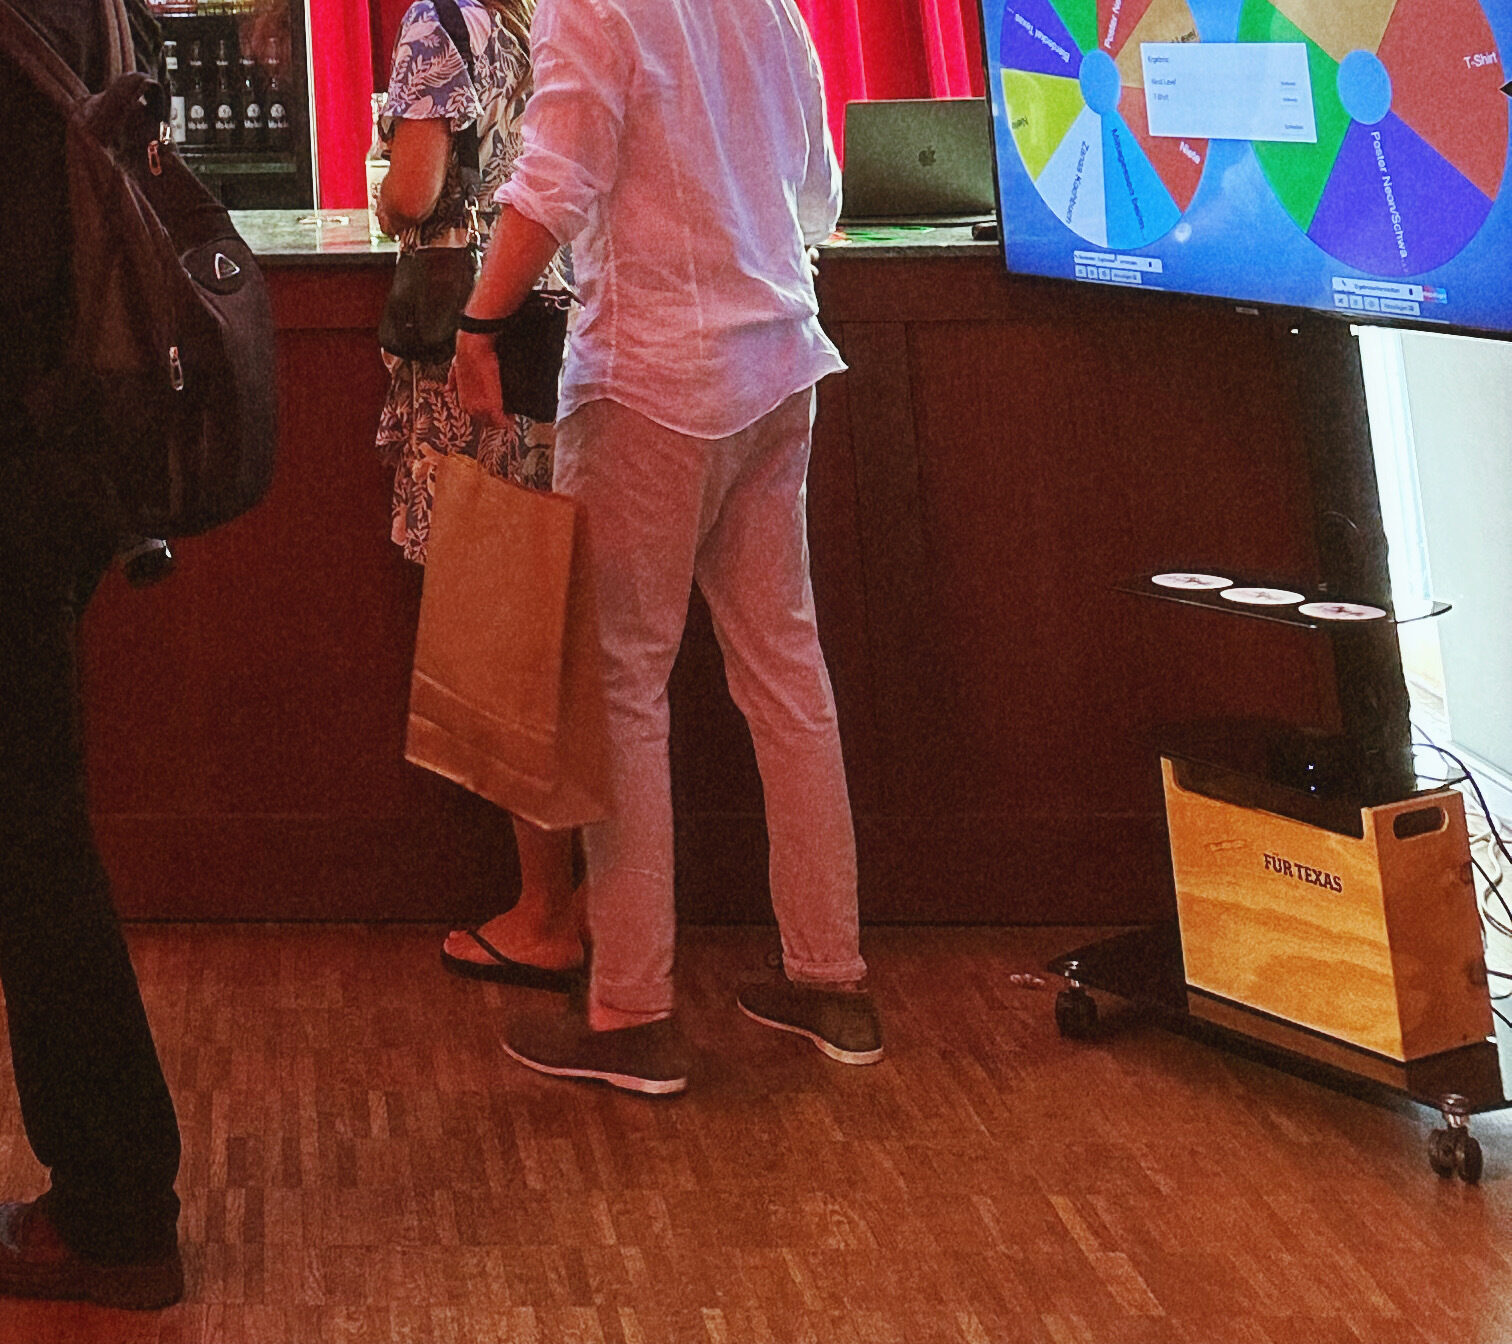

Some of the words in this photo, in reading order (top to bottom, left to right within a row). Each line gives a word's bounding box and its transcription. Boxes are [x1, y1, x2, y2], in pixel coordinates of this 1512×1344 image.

[1104, 15, 1119, 49] Poster
[1463, 51, 1498, 69] T-Shirt
[1371, 130, 1388, 173] Poster
[1263, 852, 1293, 878] FÜR
[1294, 863, 1343, 893] TEXAS
